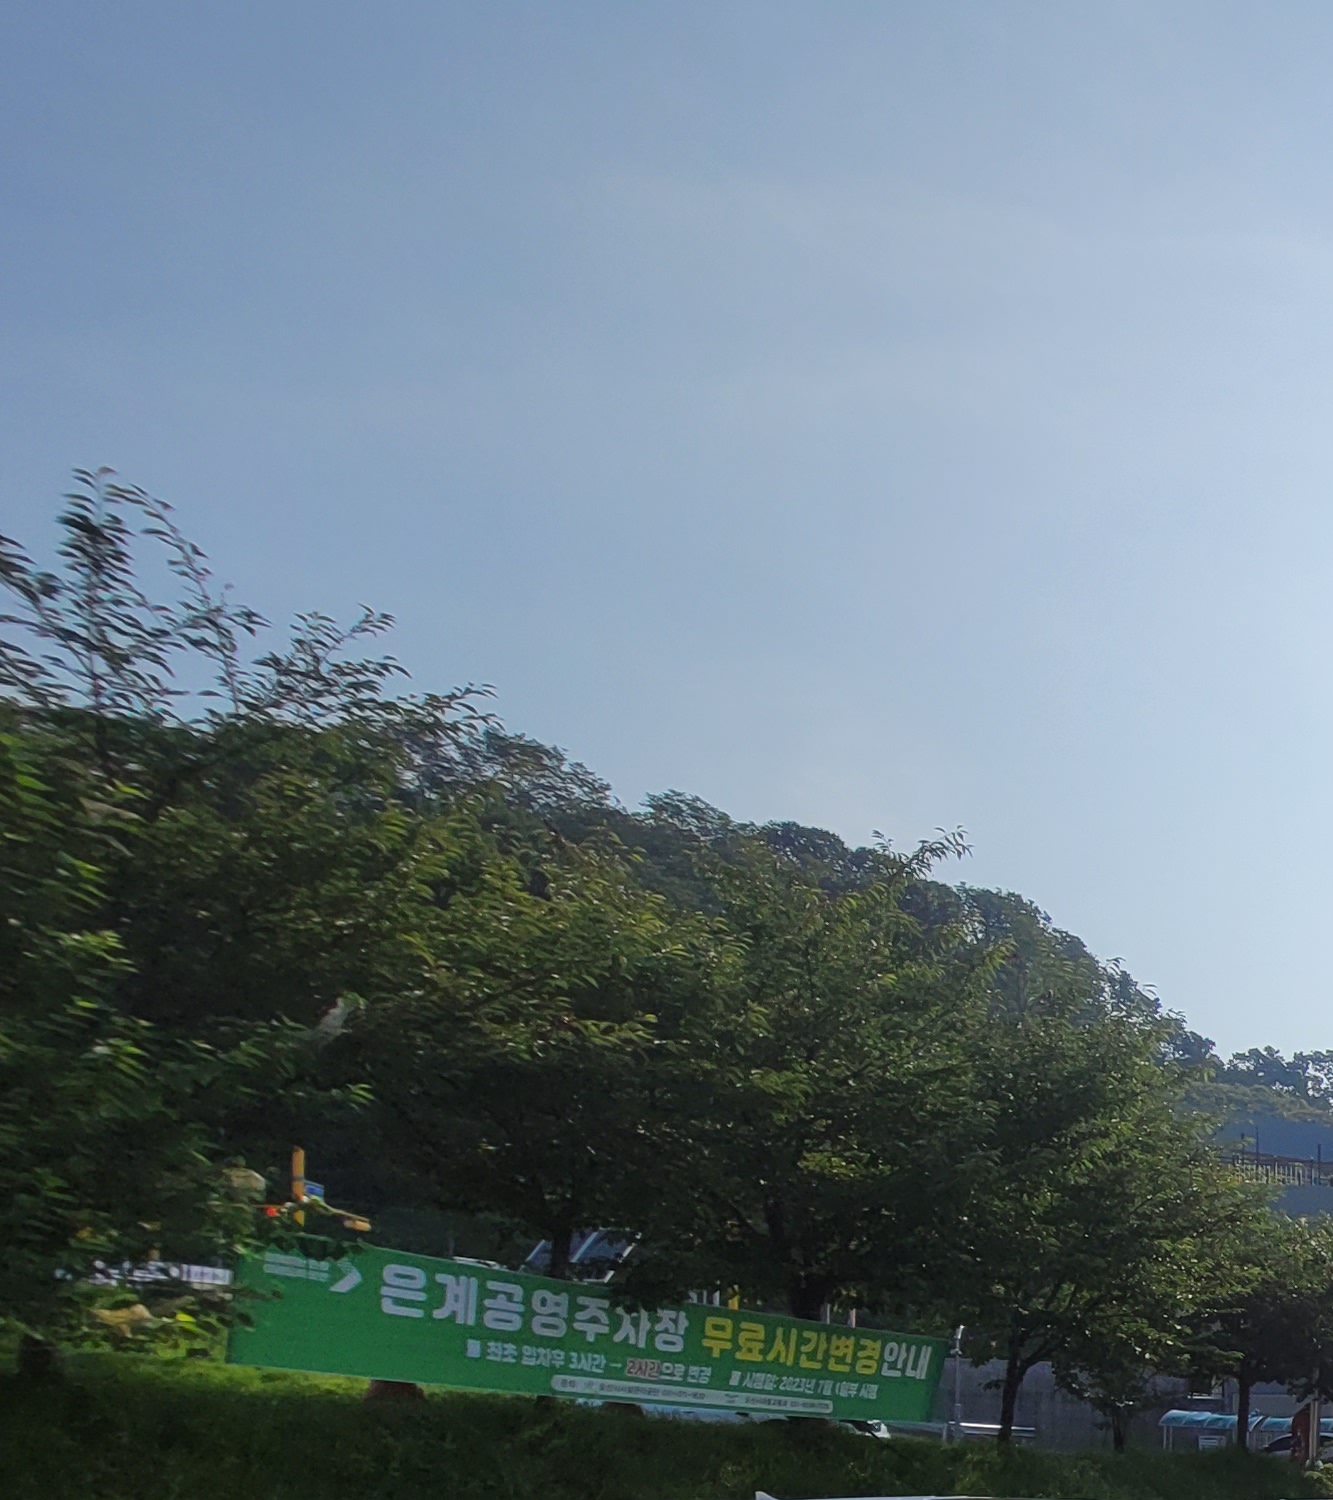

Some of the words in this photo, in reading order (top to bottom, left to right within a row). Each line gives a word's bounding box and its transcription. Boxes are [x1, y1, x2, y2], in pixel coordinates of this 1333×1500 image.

[379, 1262, 691, 1354] 은계공영주차장
[701, 1315, 934, 1381] 무료시간변경안내
[568, 1351, 606, 1374] 3시간
[625, 1358, 686, 1383] 2시간으로
